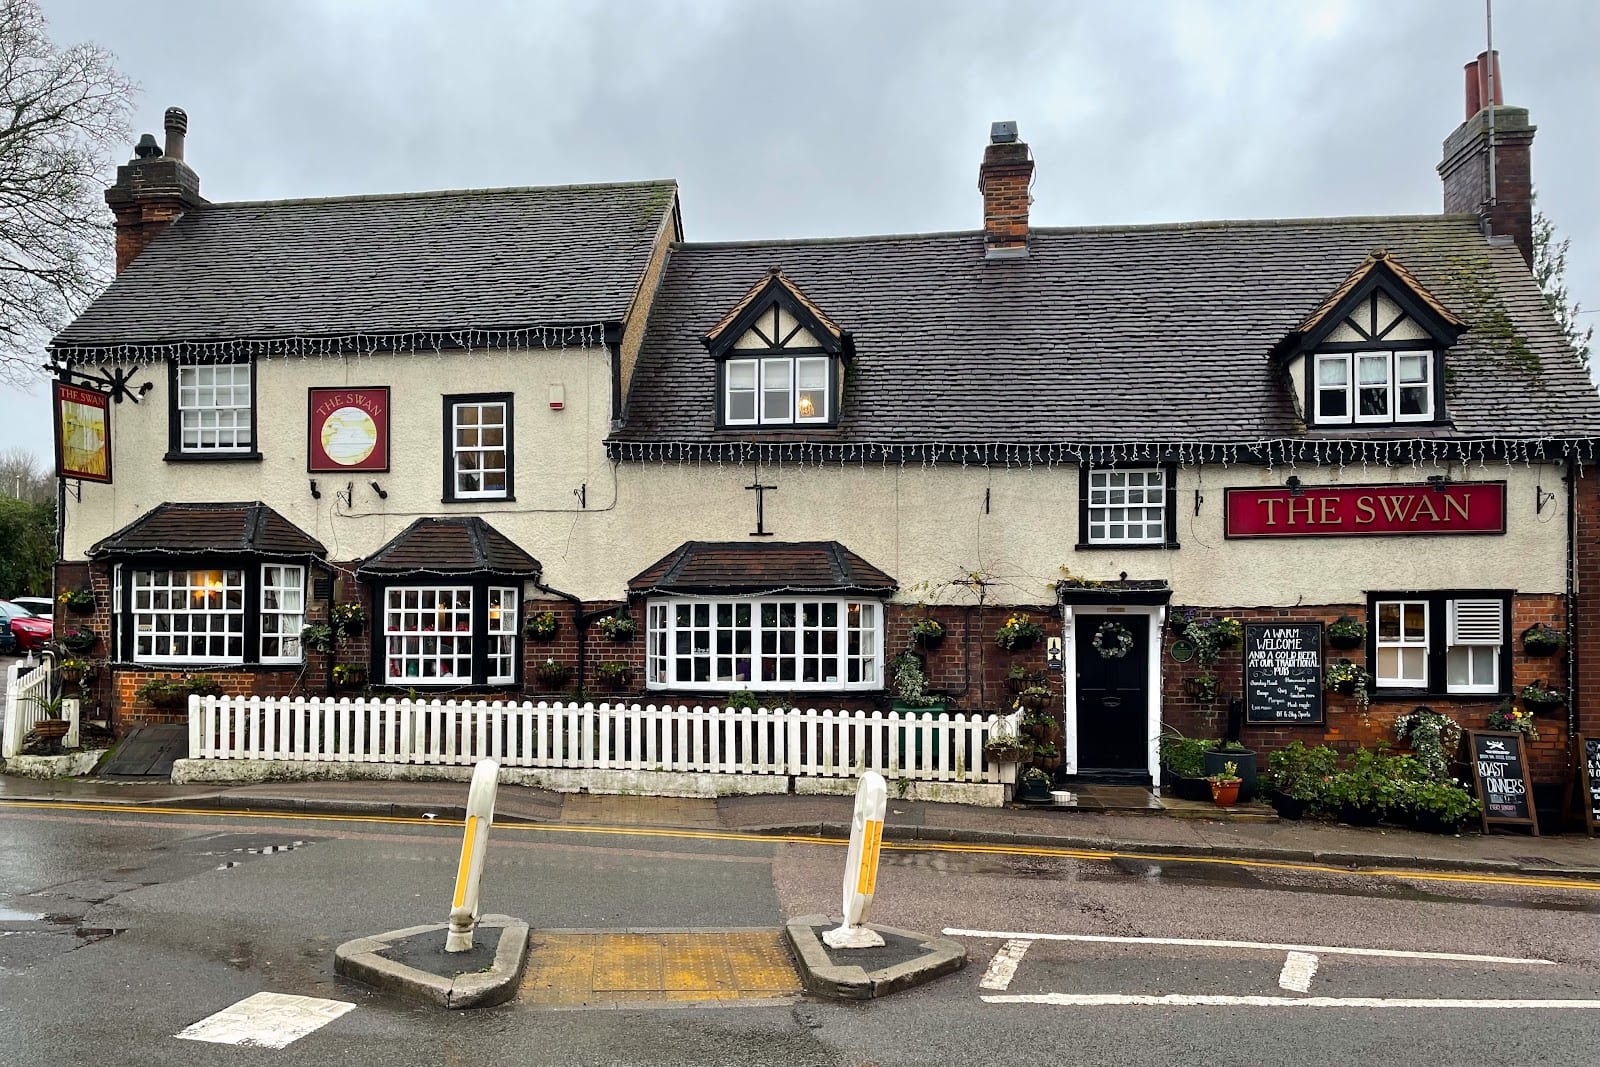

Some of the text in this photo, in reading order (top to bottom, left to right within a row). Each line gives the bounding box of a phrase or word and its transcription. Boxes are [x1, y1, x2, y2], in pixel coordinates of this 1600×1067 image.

[60, 388, 105, 406] THE SWAN
[316, 393, 382, 416] THE SWAN
[1257, 494, 1471, 525] THE SWAN
[1263, 629, 1299, 638] A WARM
[1256, 638, 1302, 650] WELCOME
[1248, 650, 1317, 660] AND A COLD BEER
[1249, 659, 1320, 668] AT OUR TRADITIONAL
[1273, 667, 1289, 676] PUB
[1477, 760, 1509, 777] ROAST
[1486, 778, 1526, 794] DINNERS
